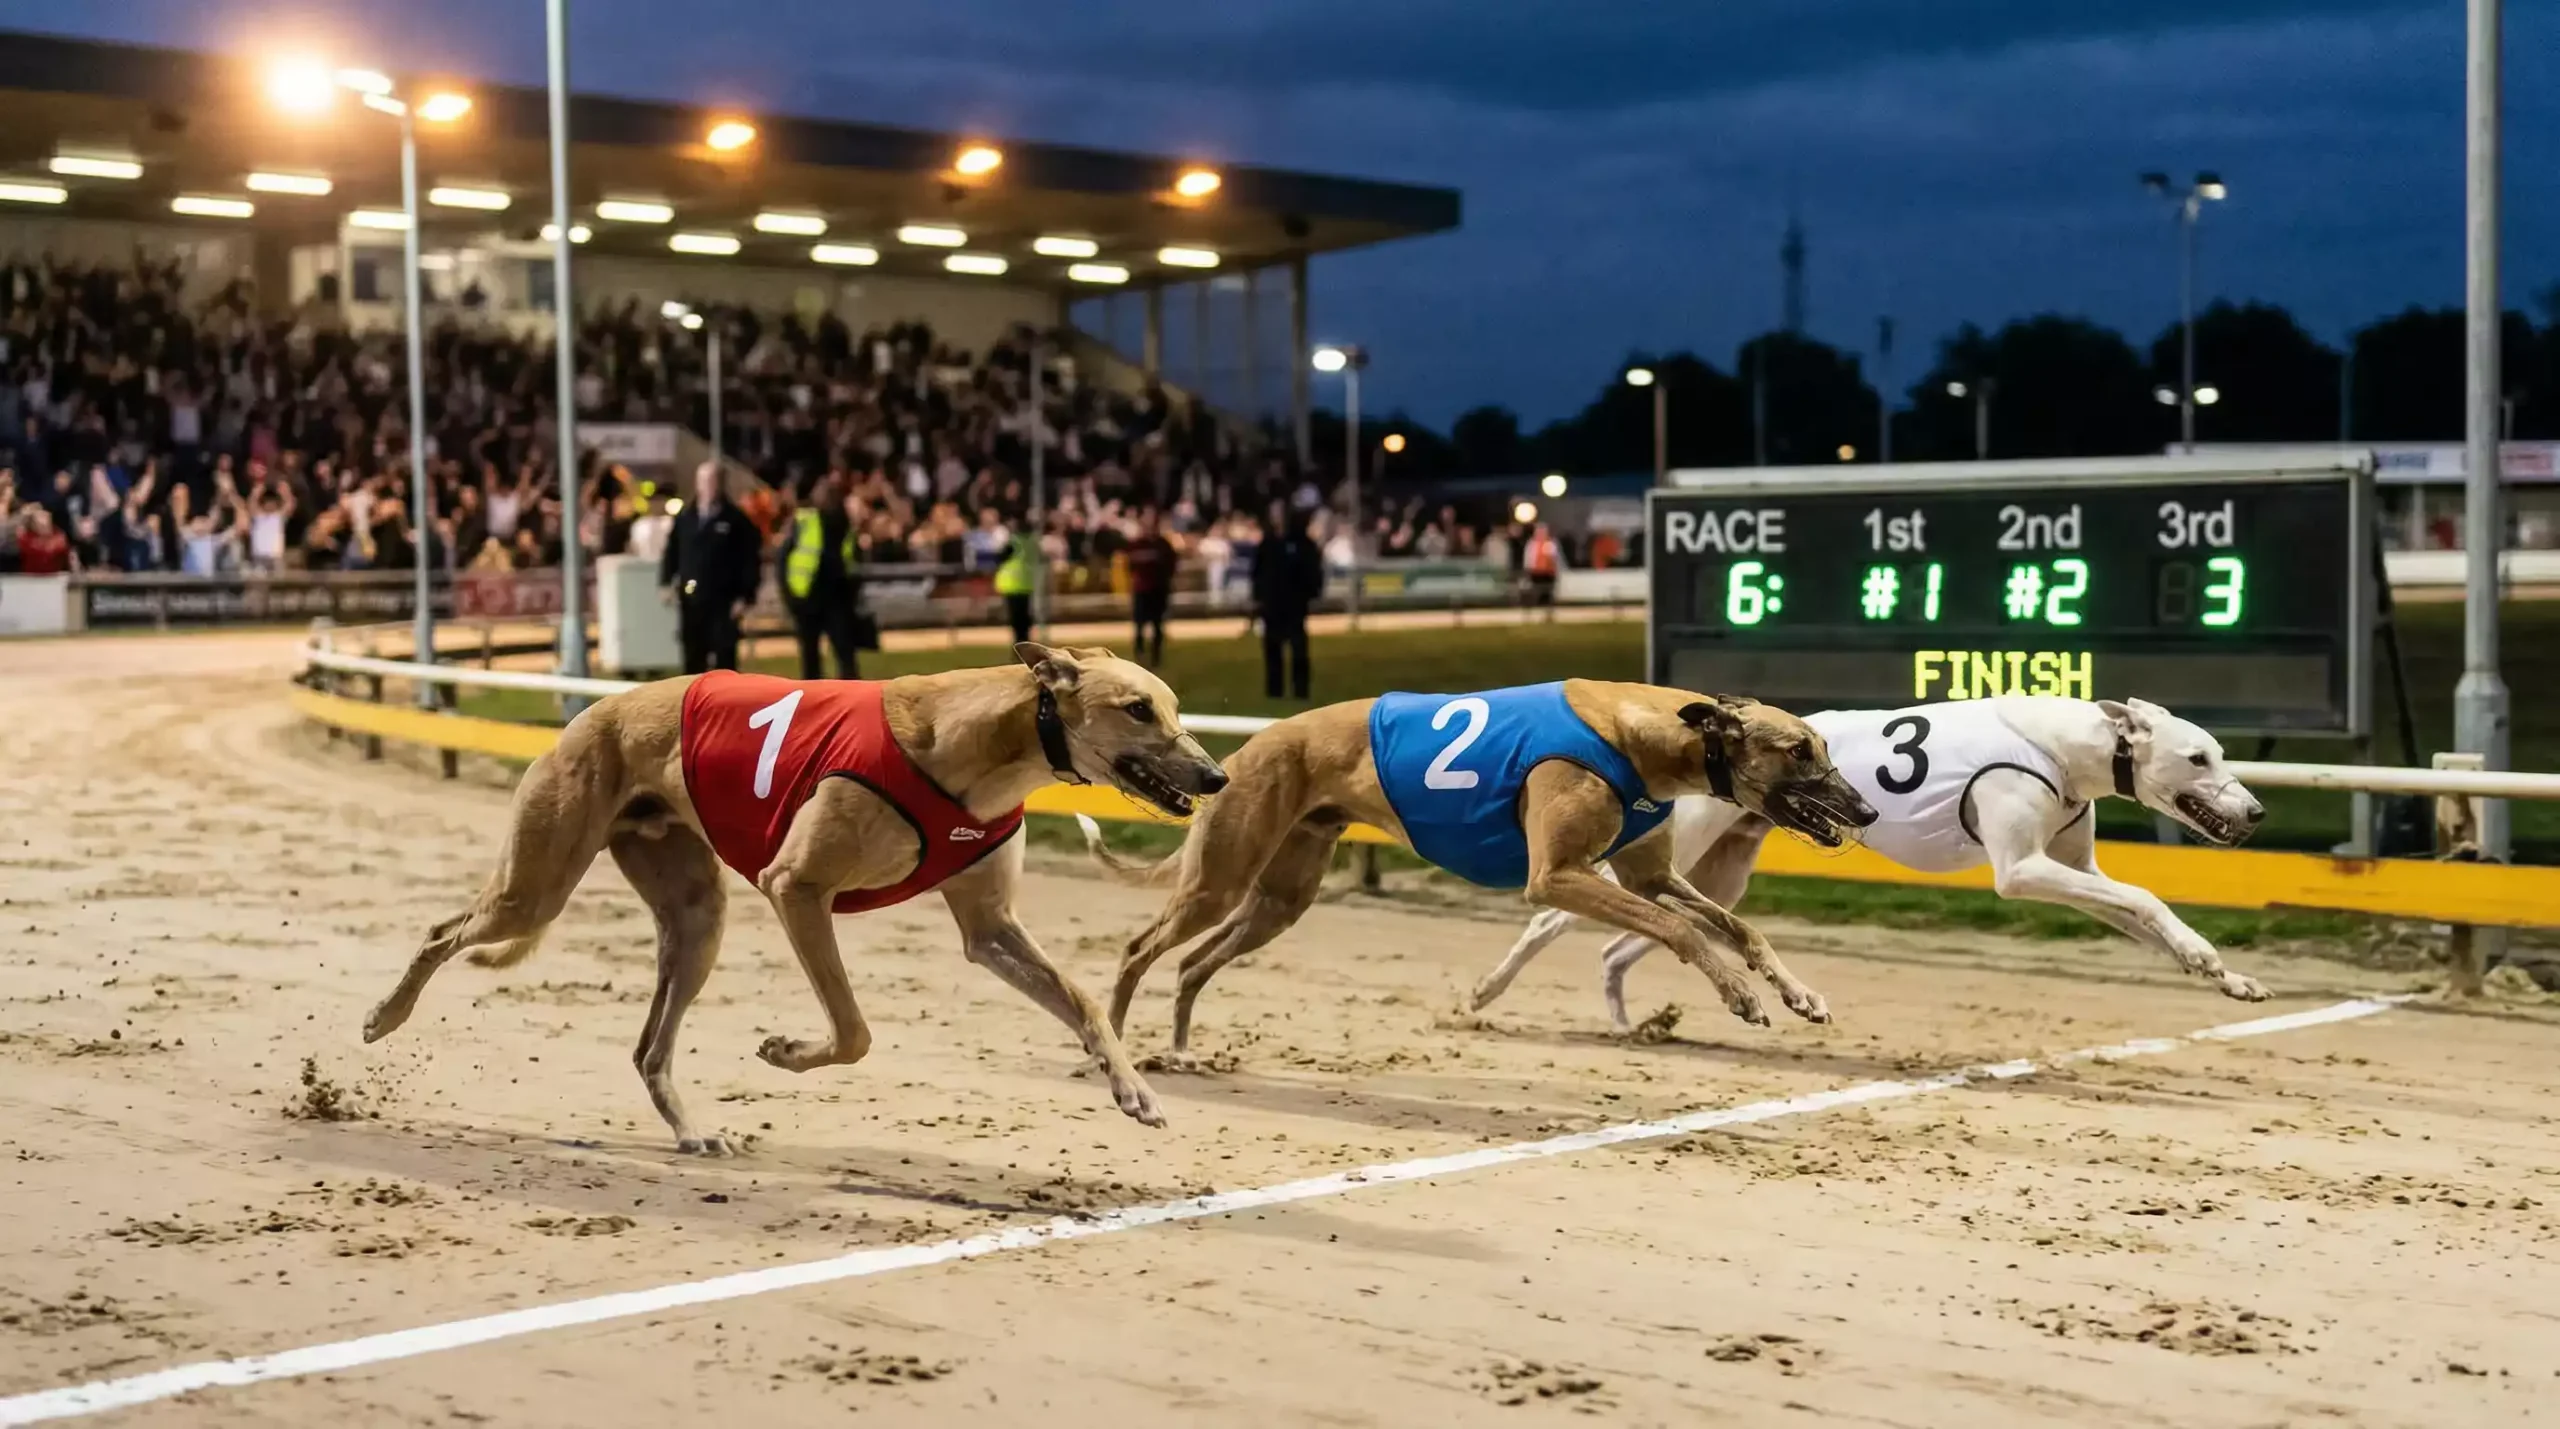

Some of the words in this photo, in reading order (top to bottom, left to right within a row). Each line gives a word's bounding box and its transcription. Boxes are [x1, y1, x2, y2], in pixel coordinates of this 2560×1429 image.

[1665, 510, 1786, 553] RACE
[1863, 508, 1926, 552] 1st
[1997, 504, 2082, 550] 2nd
[2157, 500, 2234, 549] 3rd
[1726, 561, 1785, 625] 6:
[2004, 558, 2089, 626] #2
[2201, 556, 2245, 626] 3
[1914, 650, 2093, 700] FINISH
[748, 689, 805, 799] 1
[1424, 697, 1490, 790] 2
[1875, 715, 1931, 795] 3
